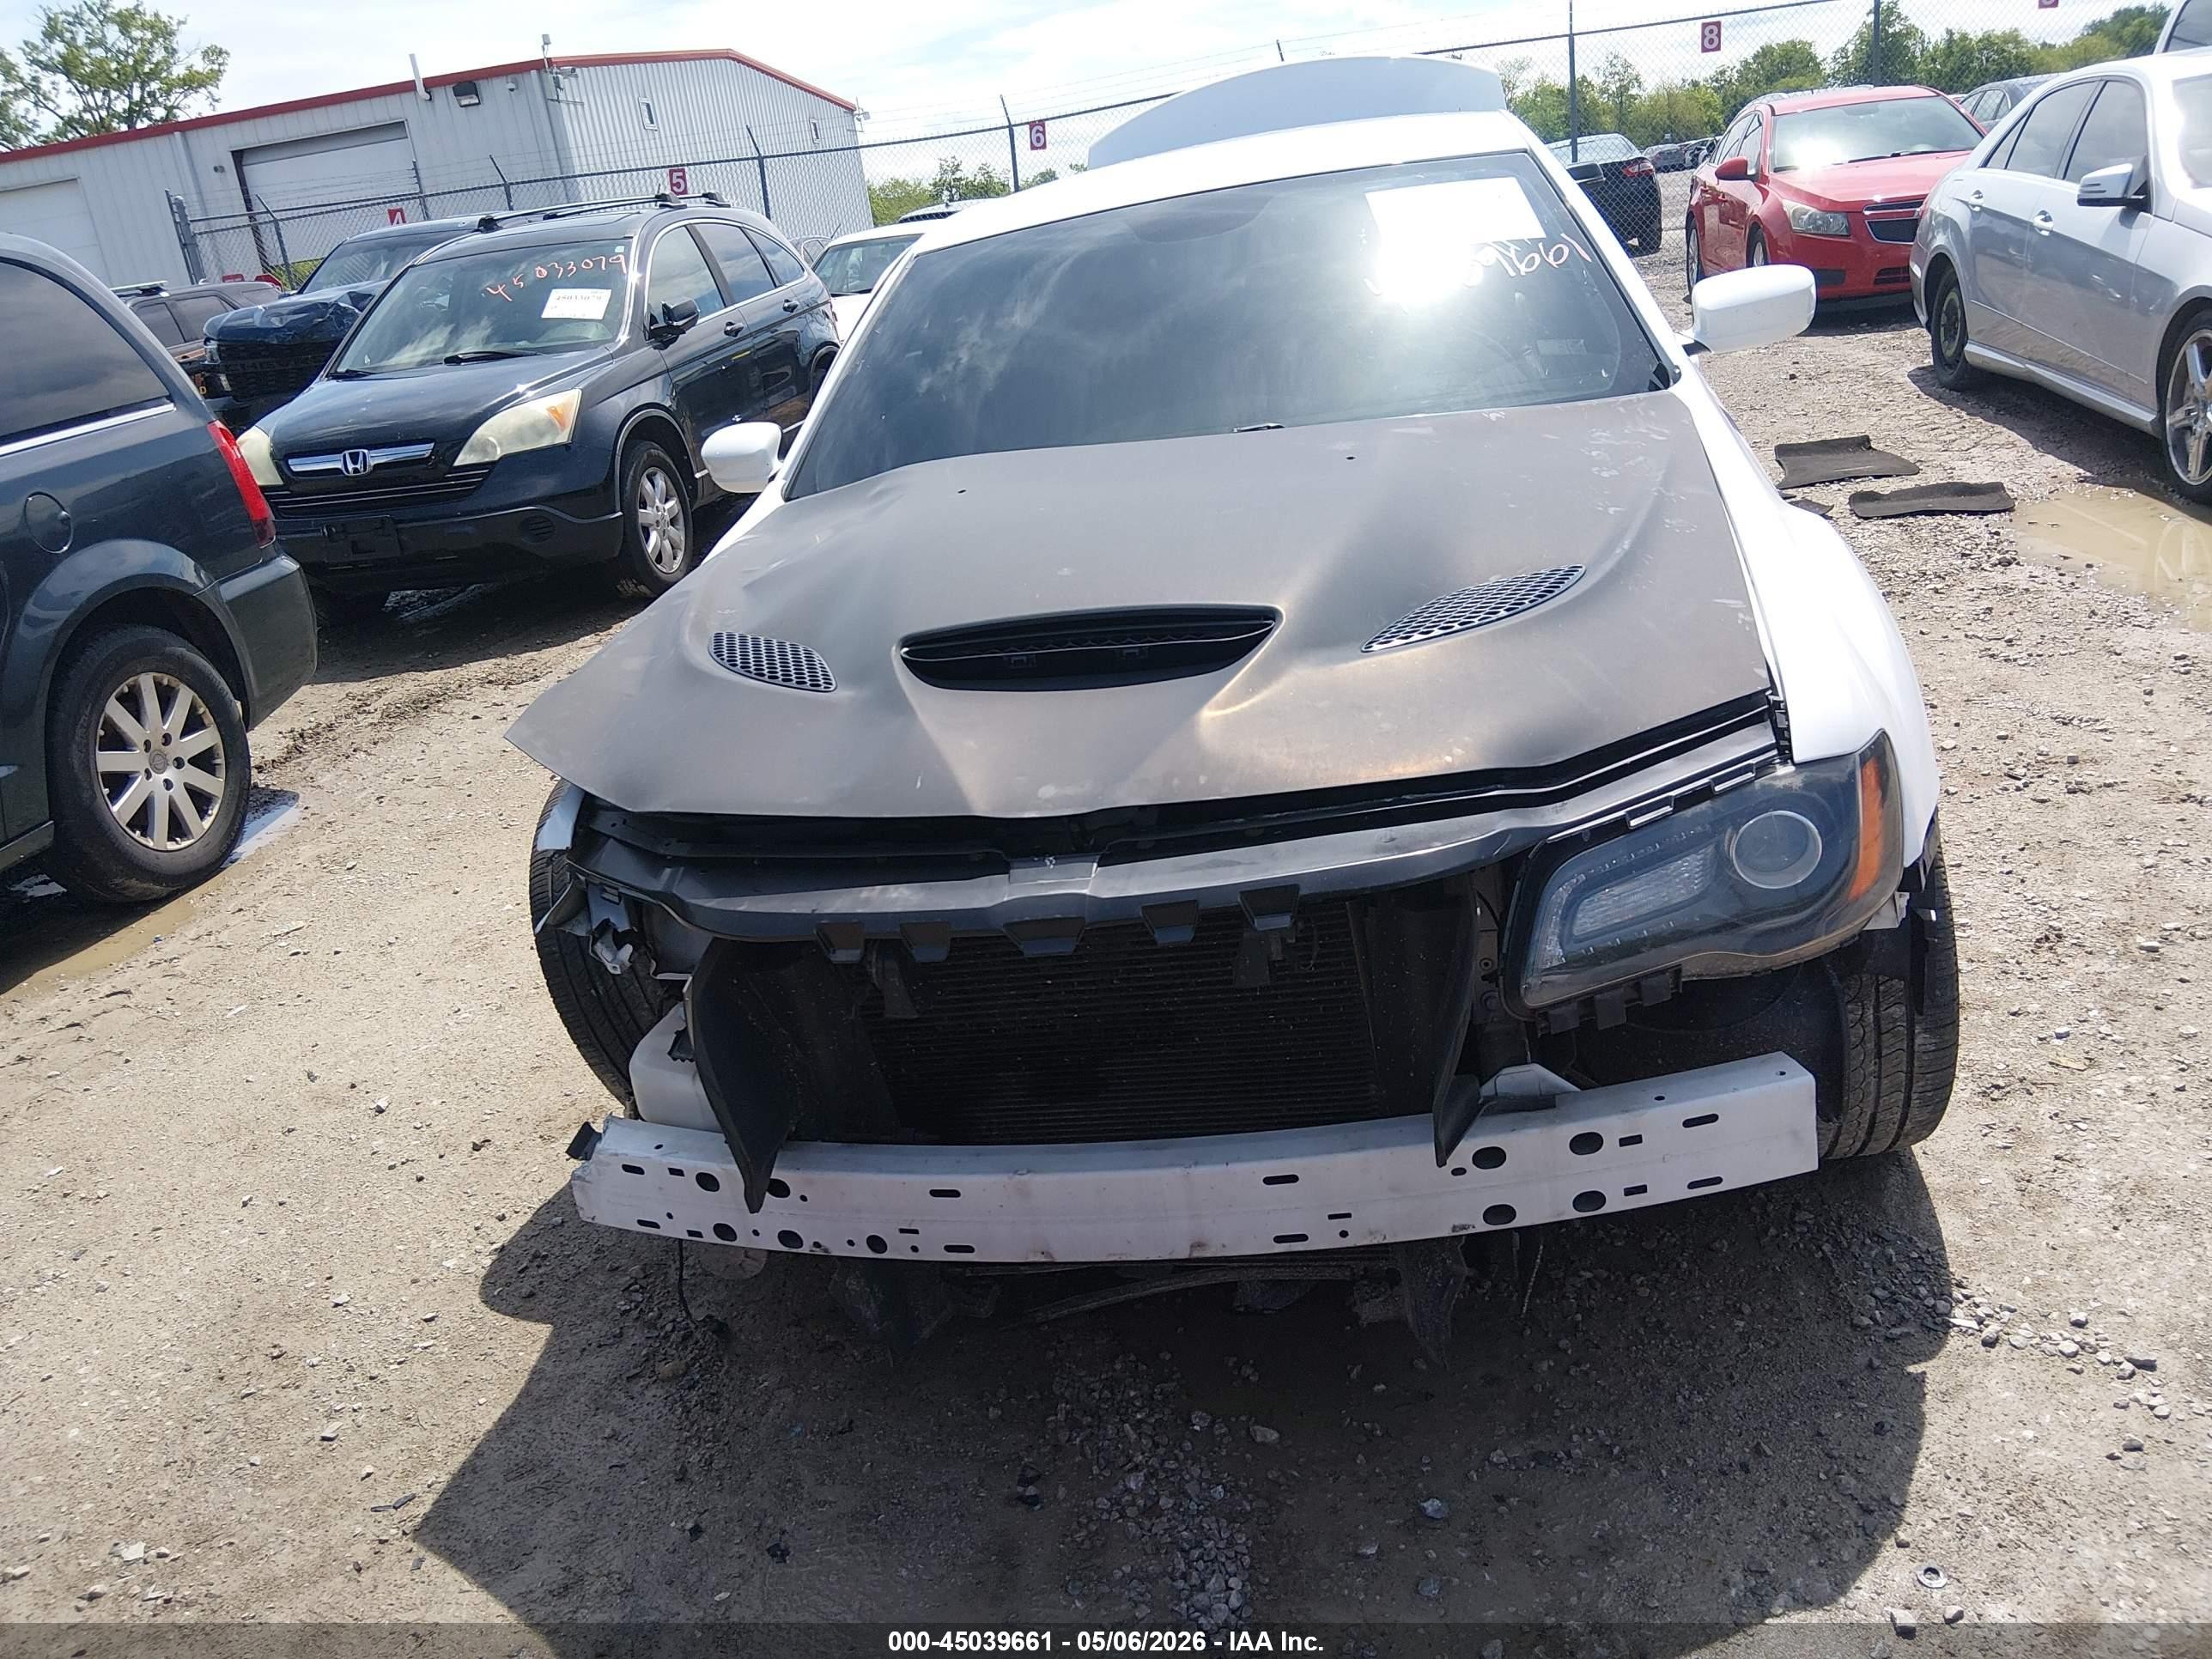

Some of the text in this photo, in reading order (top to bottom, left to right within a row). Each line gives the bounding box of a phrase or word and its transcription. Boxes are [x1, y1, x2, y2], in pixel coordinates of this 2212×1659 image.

[1704, 25, 1719, 49] 8
[1031, 125, 1044, 147] 6
[672, 172, 685, 192] 5
